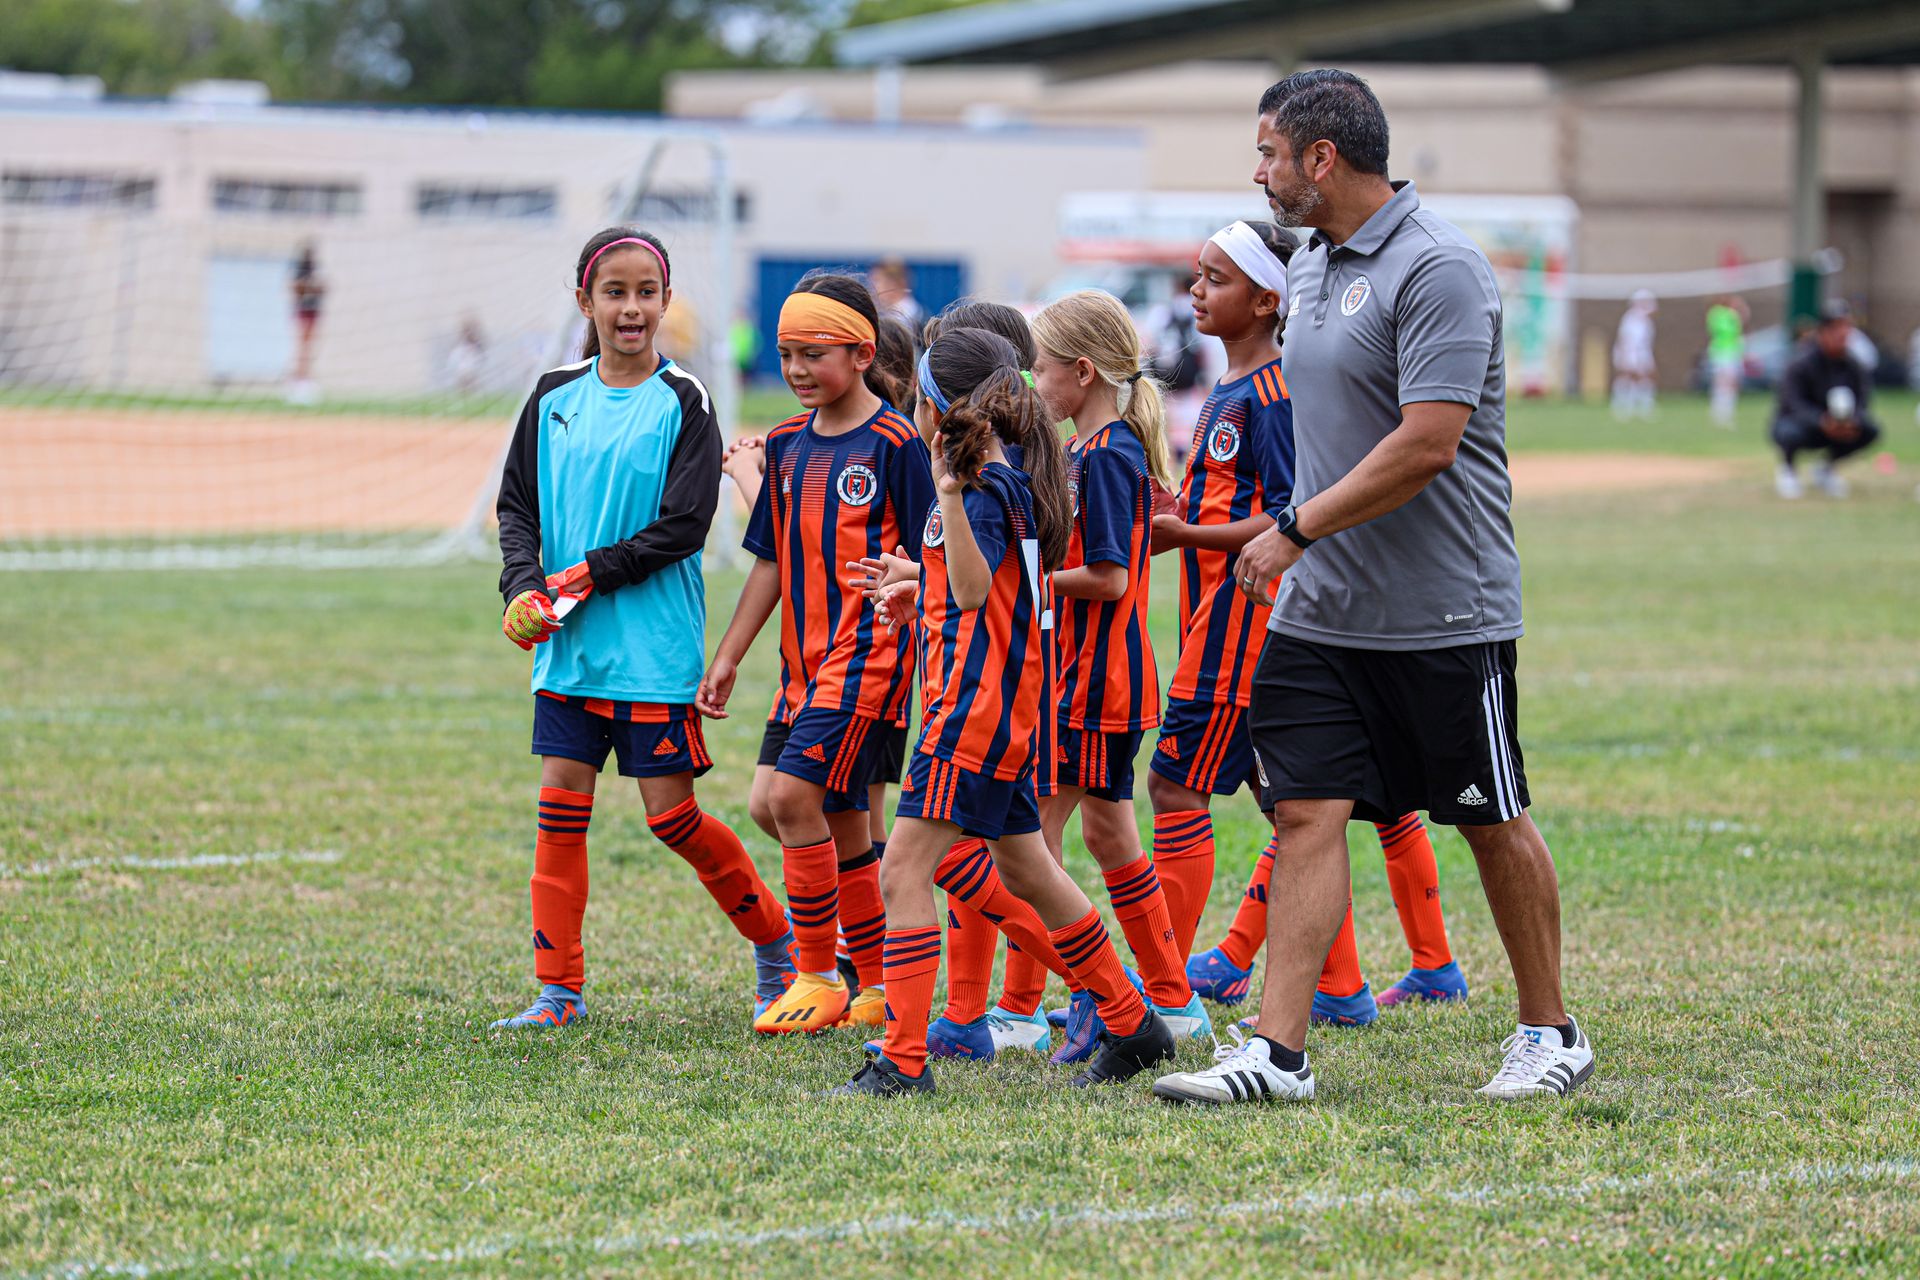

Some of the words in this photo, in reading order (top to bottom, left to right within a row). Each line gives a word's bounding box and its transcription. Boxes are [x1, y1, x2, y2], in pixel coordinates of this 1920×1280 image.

[840, 465, 876, 483] RANGERS
[653, 746, 679, 755] adidas
[802, 749, 826, 763] adidas
[1157, 742, 1180, 760] adidas
[1457, 796, 1488, 805] adidas
